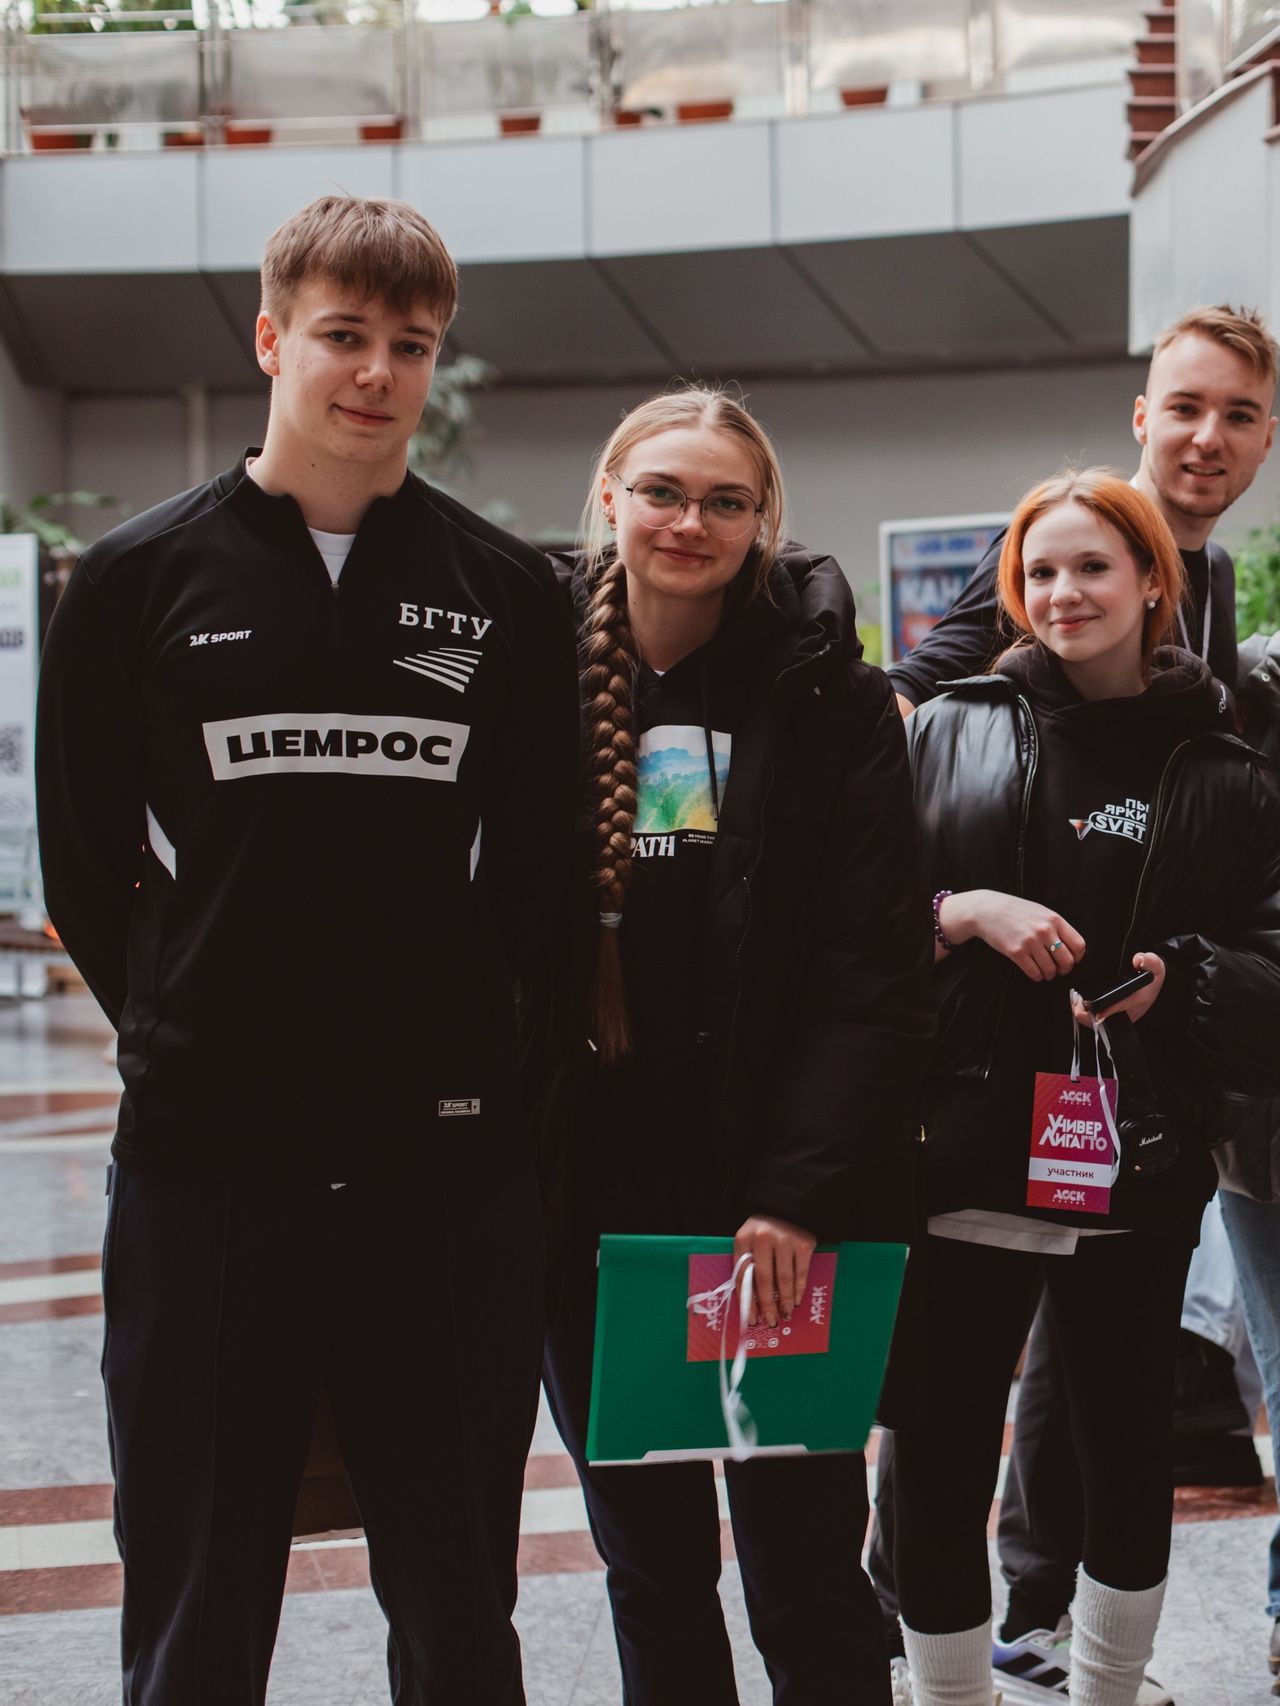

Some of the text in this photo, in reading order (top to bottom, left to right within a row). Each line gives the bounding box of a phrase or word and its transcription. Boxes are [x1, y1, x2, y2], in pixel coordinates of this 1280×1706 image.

[398, 602, 493, 640] БГТУ
[210, 630, 252, 643] SPORT
[226, 729, 452, 766] ЦЕМРОС
[1095, 815, 1147, 840] SVET
[1047, 1166, 1095, 1179] участник
